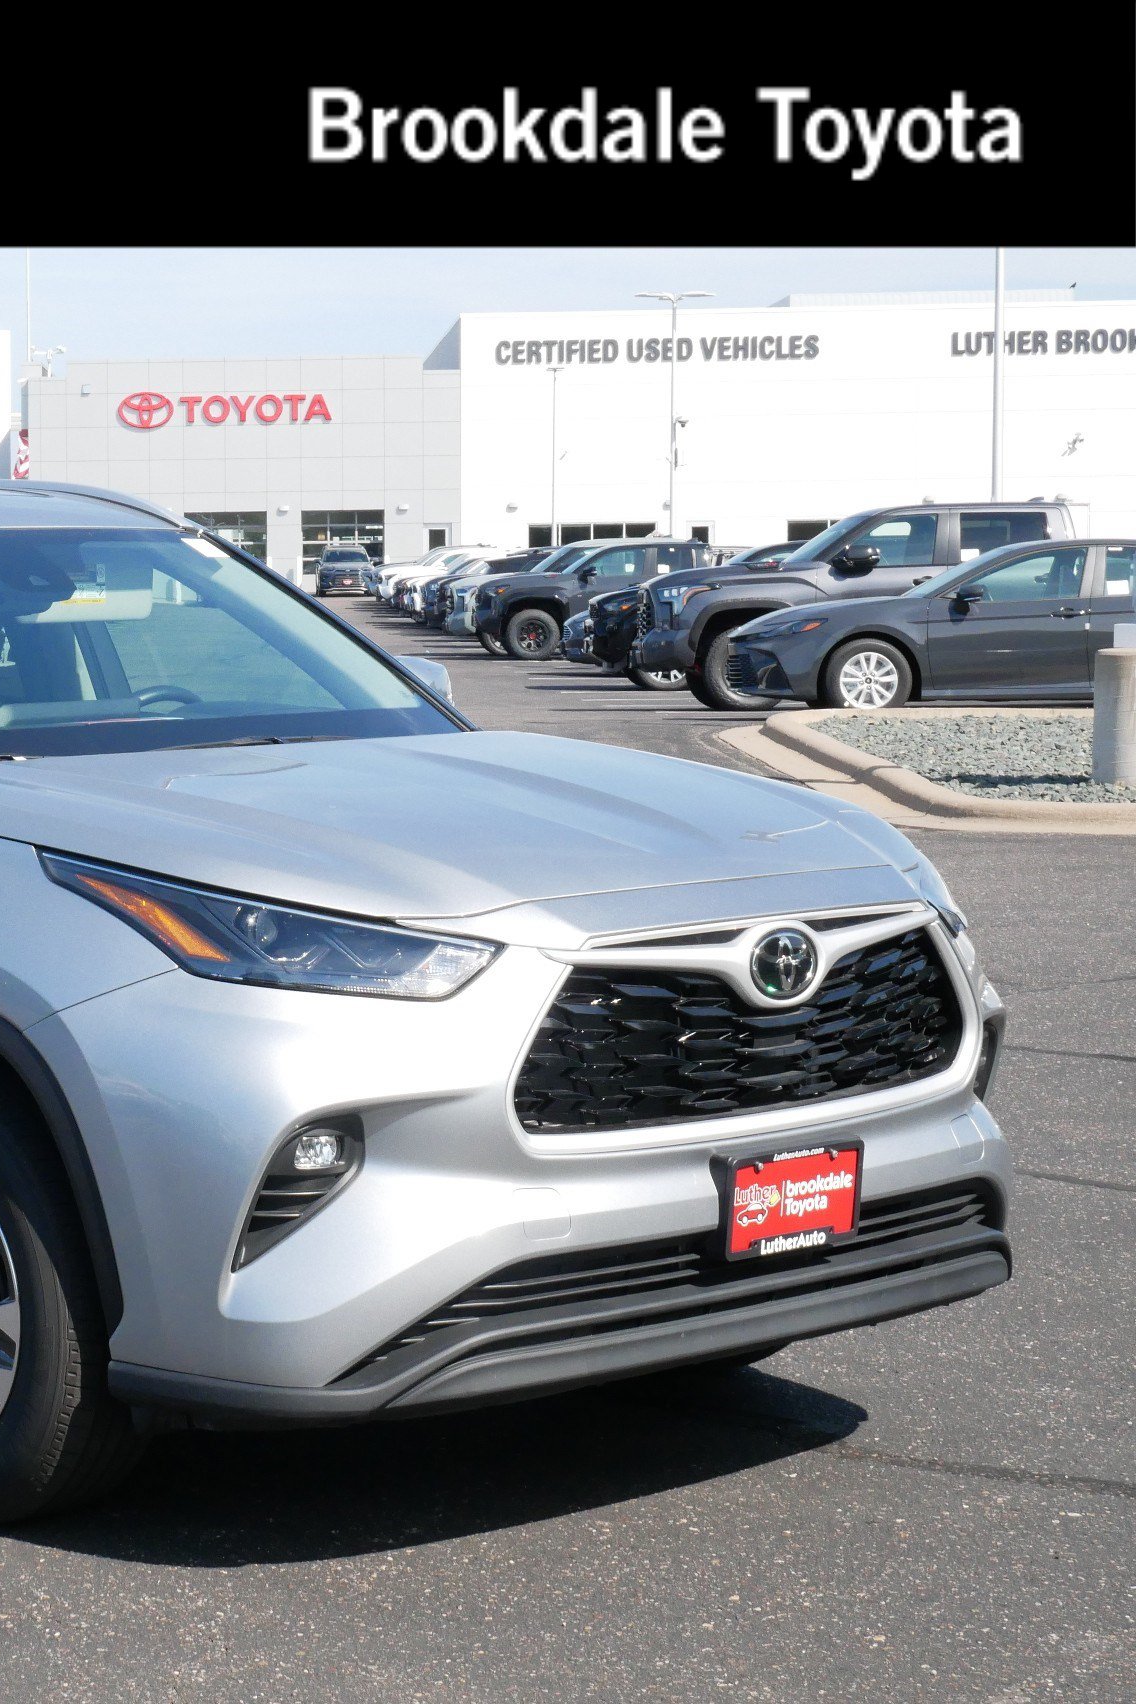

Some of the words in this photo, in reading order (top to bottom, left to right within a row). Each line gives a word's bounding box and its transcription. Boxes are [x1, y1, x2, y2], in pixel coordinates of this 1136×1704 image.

[495, 339, 619, 365] CERTIFIED
[626, 337, 694, 364] USED
[699, 334, 820, 361] VEHICLES
[951, 330, 1049, 357] LUTHER
[180, 393, 332, 423] TOYOTA
[734, 1184, 777, 1206] Luther
[785, 1170, 853, 1196] brookdale
[785, 1194, 828, 1217] Toyota
[760, 1231, 826, 1255] LutherAuto
